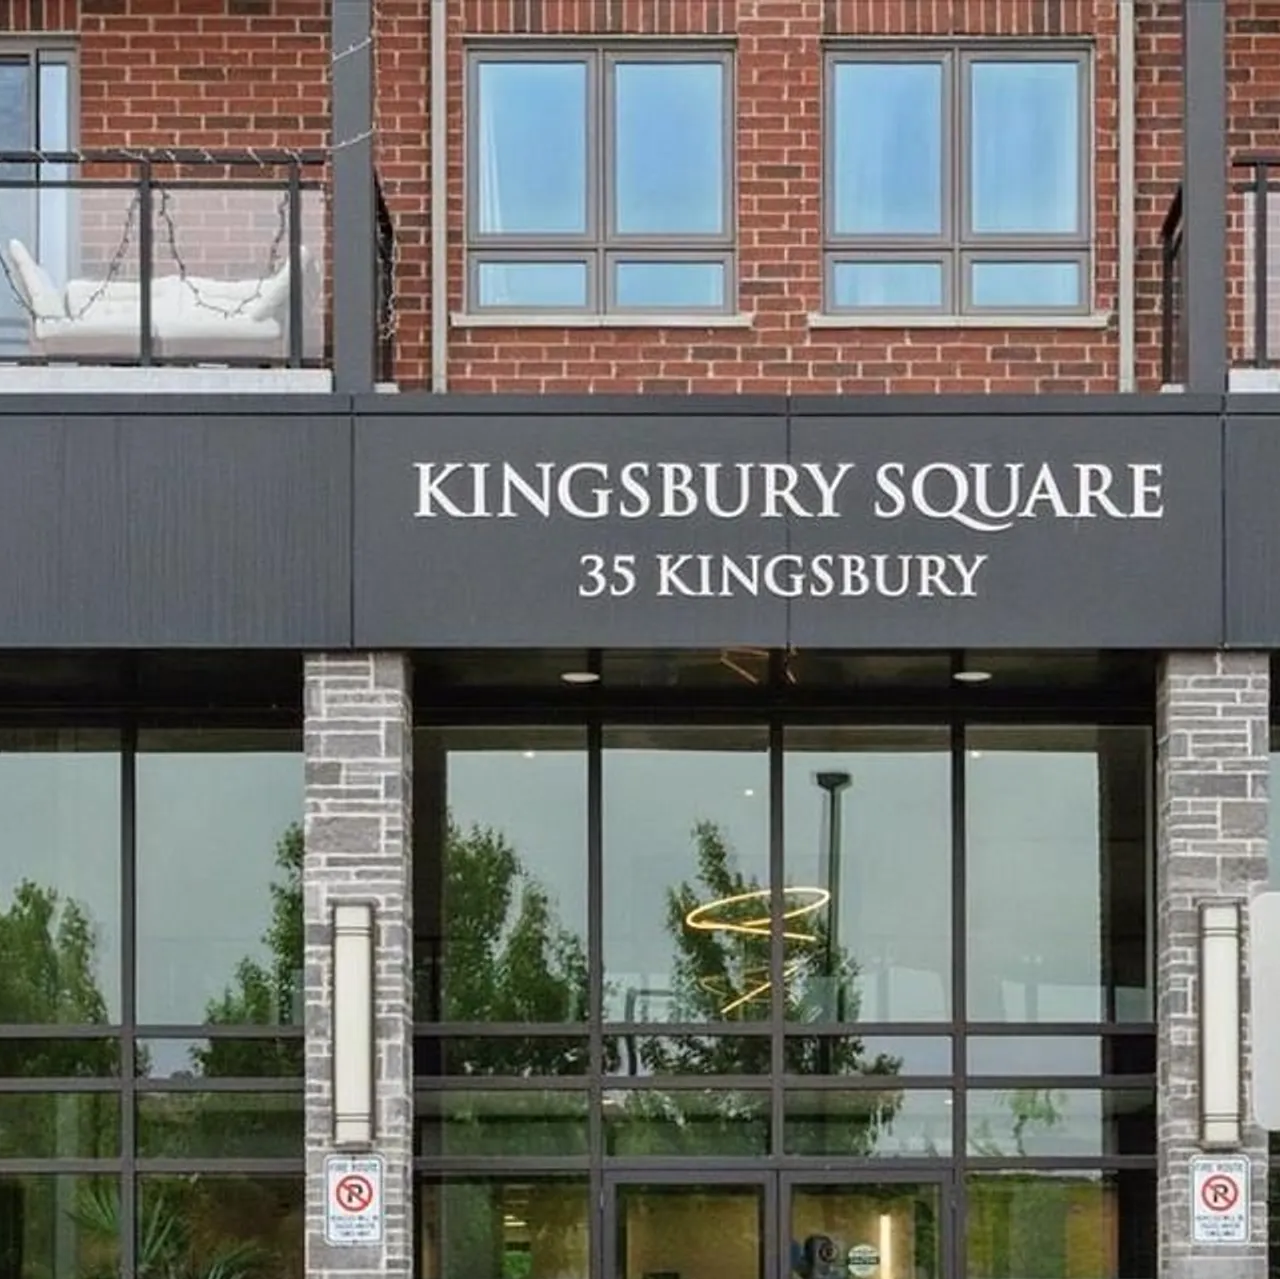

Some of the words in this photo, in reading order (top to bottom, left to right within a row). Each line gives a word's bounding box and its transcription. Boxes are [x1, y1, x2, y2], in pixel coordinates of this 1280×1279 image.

[413, 461, 855, 519] KINGSBURY
[874, 461, 1165, 532] SQUARE
[578, 554, 637, 598] 35
[656, 554, 989, 598] KINGSBURY
